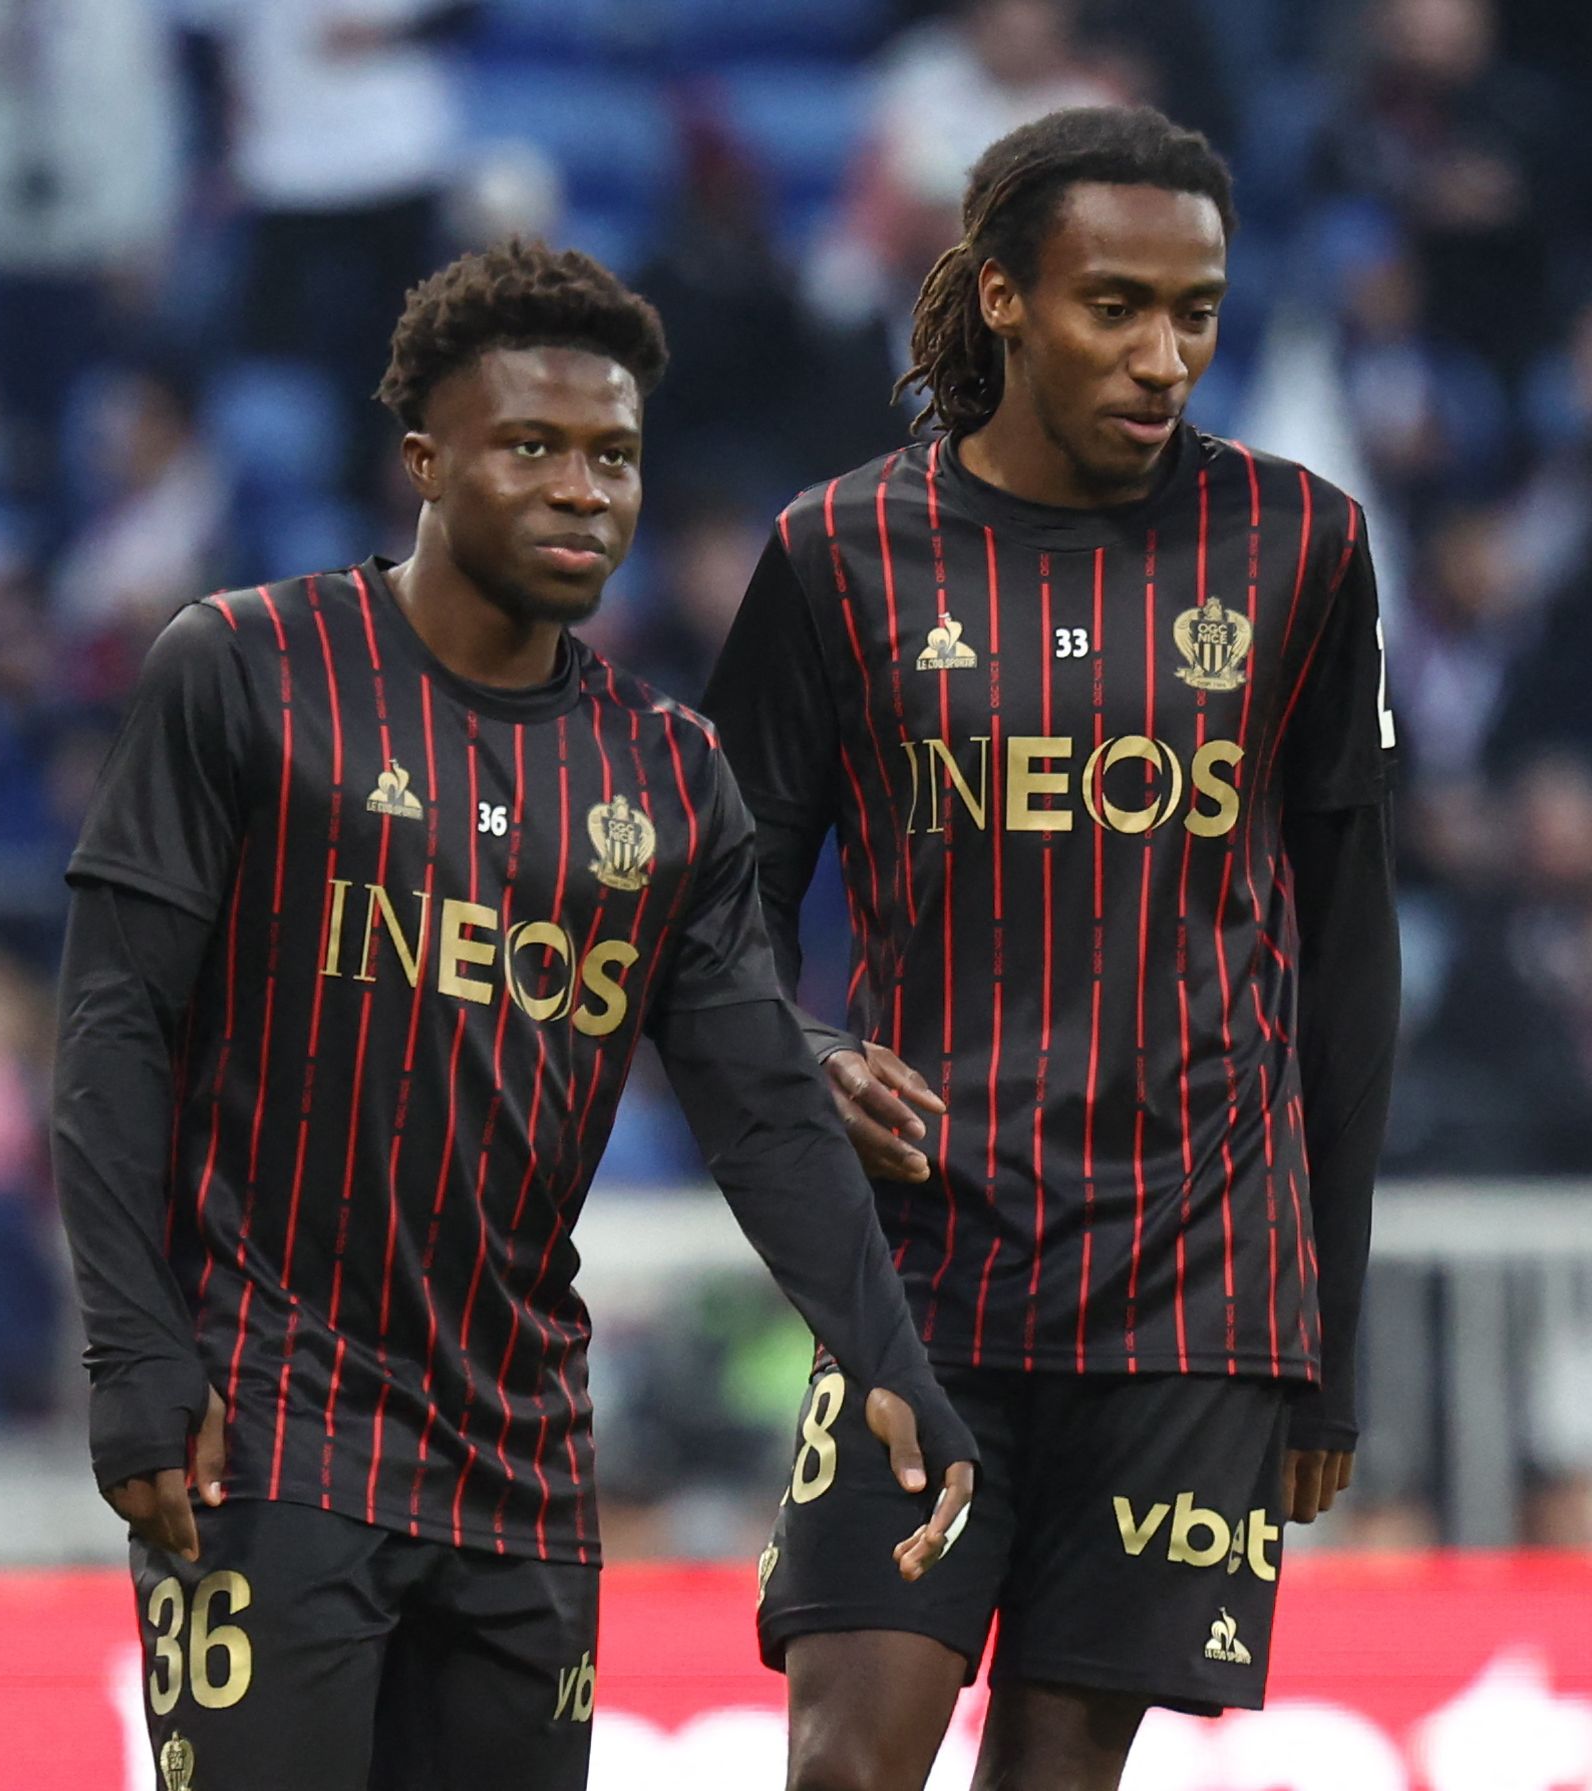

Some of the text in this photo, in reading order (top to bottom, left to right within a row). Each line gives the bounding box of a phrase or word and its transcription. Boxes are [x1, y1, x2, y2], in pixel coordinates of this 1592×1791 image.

[1055, 628, 1089, 658] 33
[1198, 623, 1228, 635] OGC
[1198, 632, 1228, 645] NICE
[916, 659, 928, 671] LE
[901, 734, 1245, 837] INEOS
[477, 802, 507, 836] 36
[319, 878, 639, 1037] INEOS
[780, 1372, 846, 1506] 8
[1113, 1491, 1279, 1581] vbet
[147, 1570, 252, 1716] 36
